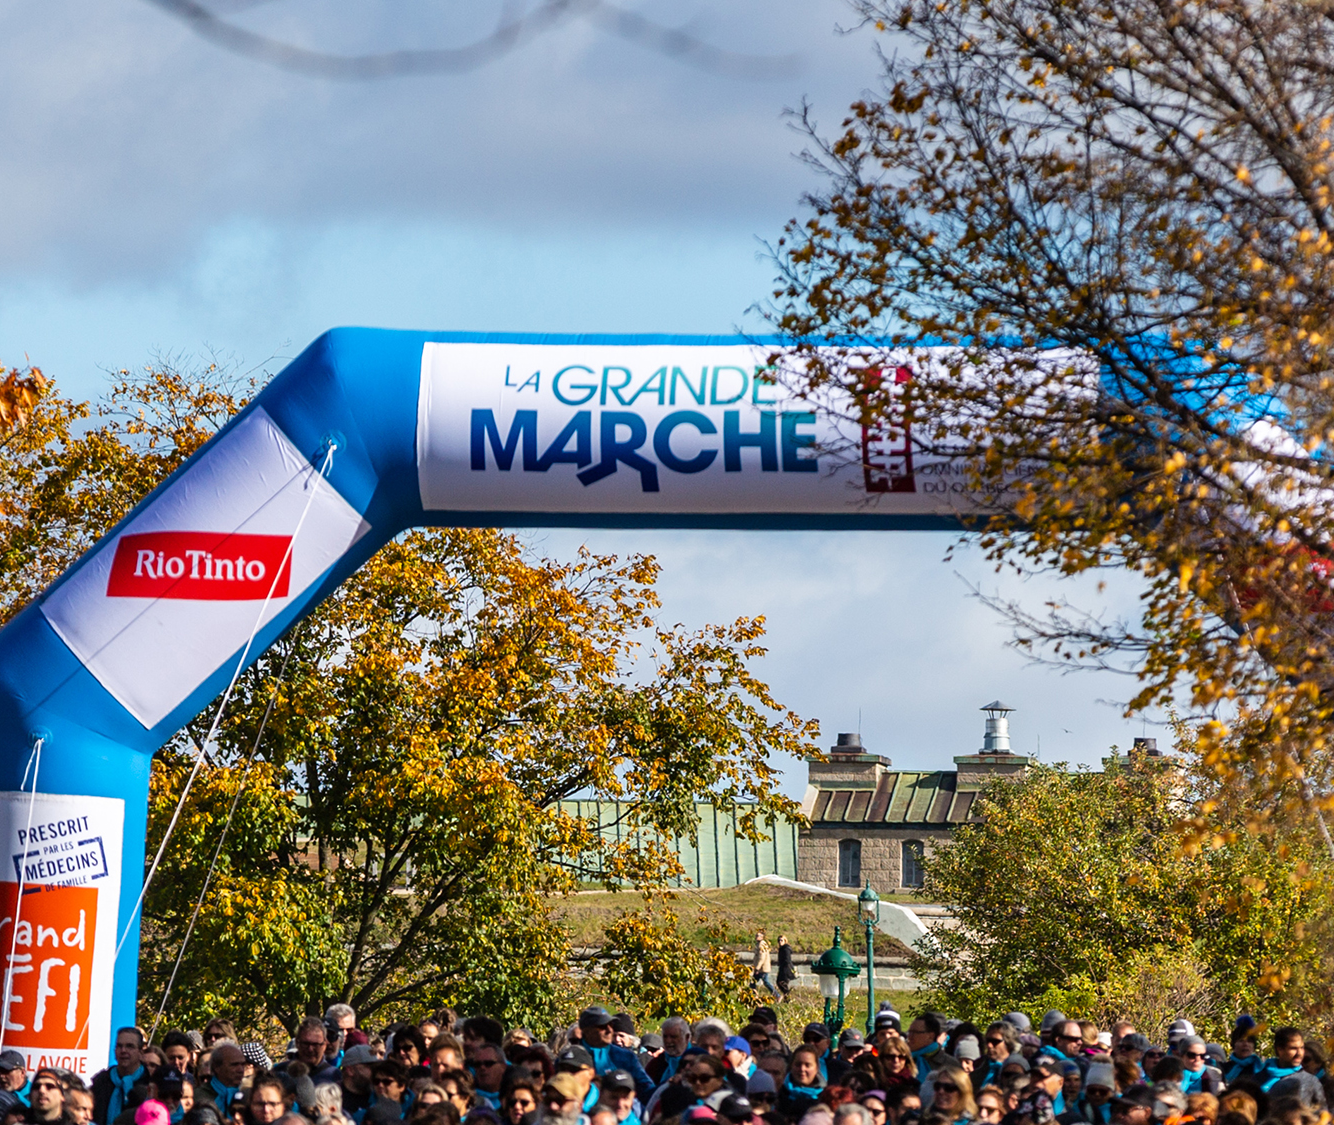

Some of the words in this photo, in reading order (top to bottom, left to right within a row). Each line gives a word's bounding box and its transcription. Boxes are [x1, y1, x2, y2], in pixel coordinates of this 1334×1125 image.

[504, 365, 541, 393] LA
[552, 365, 778, 407] GRANDE
[470, 408, 819, 493] MARCHE
[17, 815, 89, 846] PRESCRIT
[43, 844, 59, 855] PAR
[60, 841, 74, 852] LES
[24, 851, 99, 881] MÉDECINS
[44, 882, 55, 893] DE
[57, 875, 88, 890] FAMILLE
[27, 1054, 88, 1074] LAVOIE
